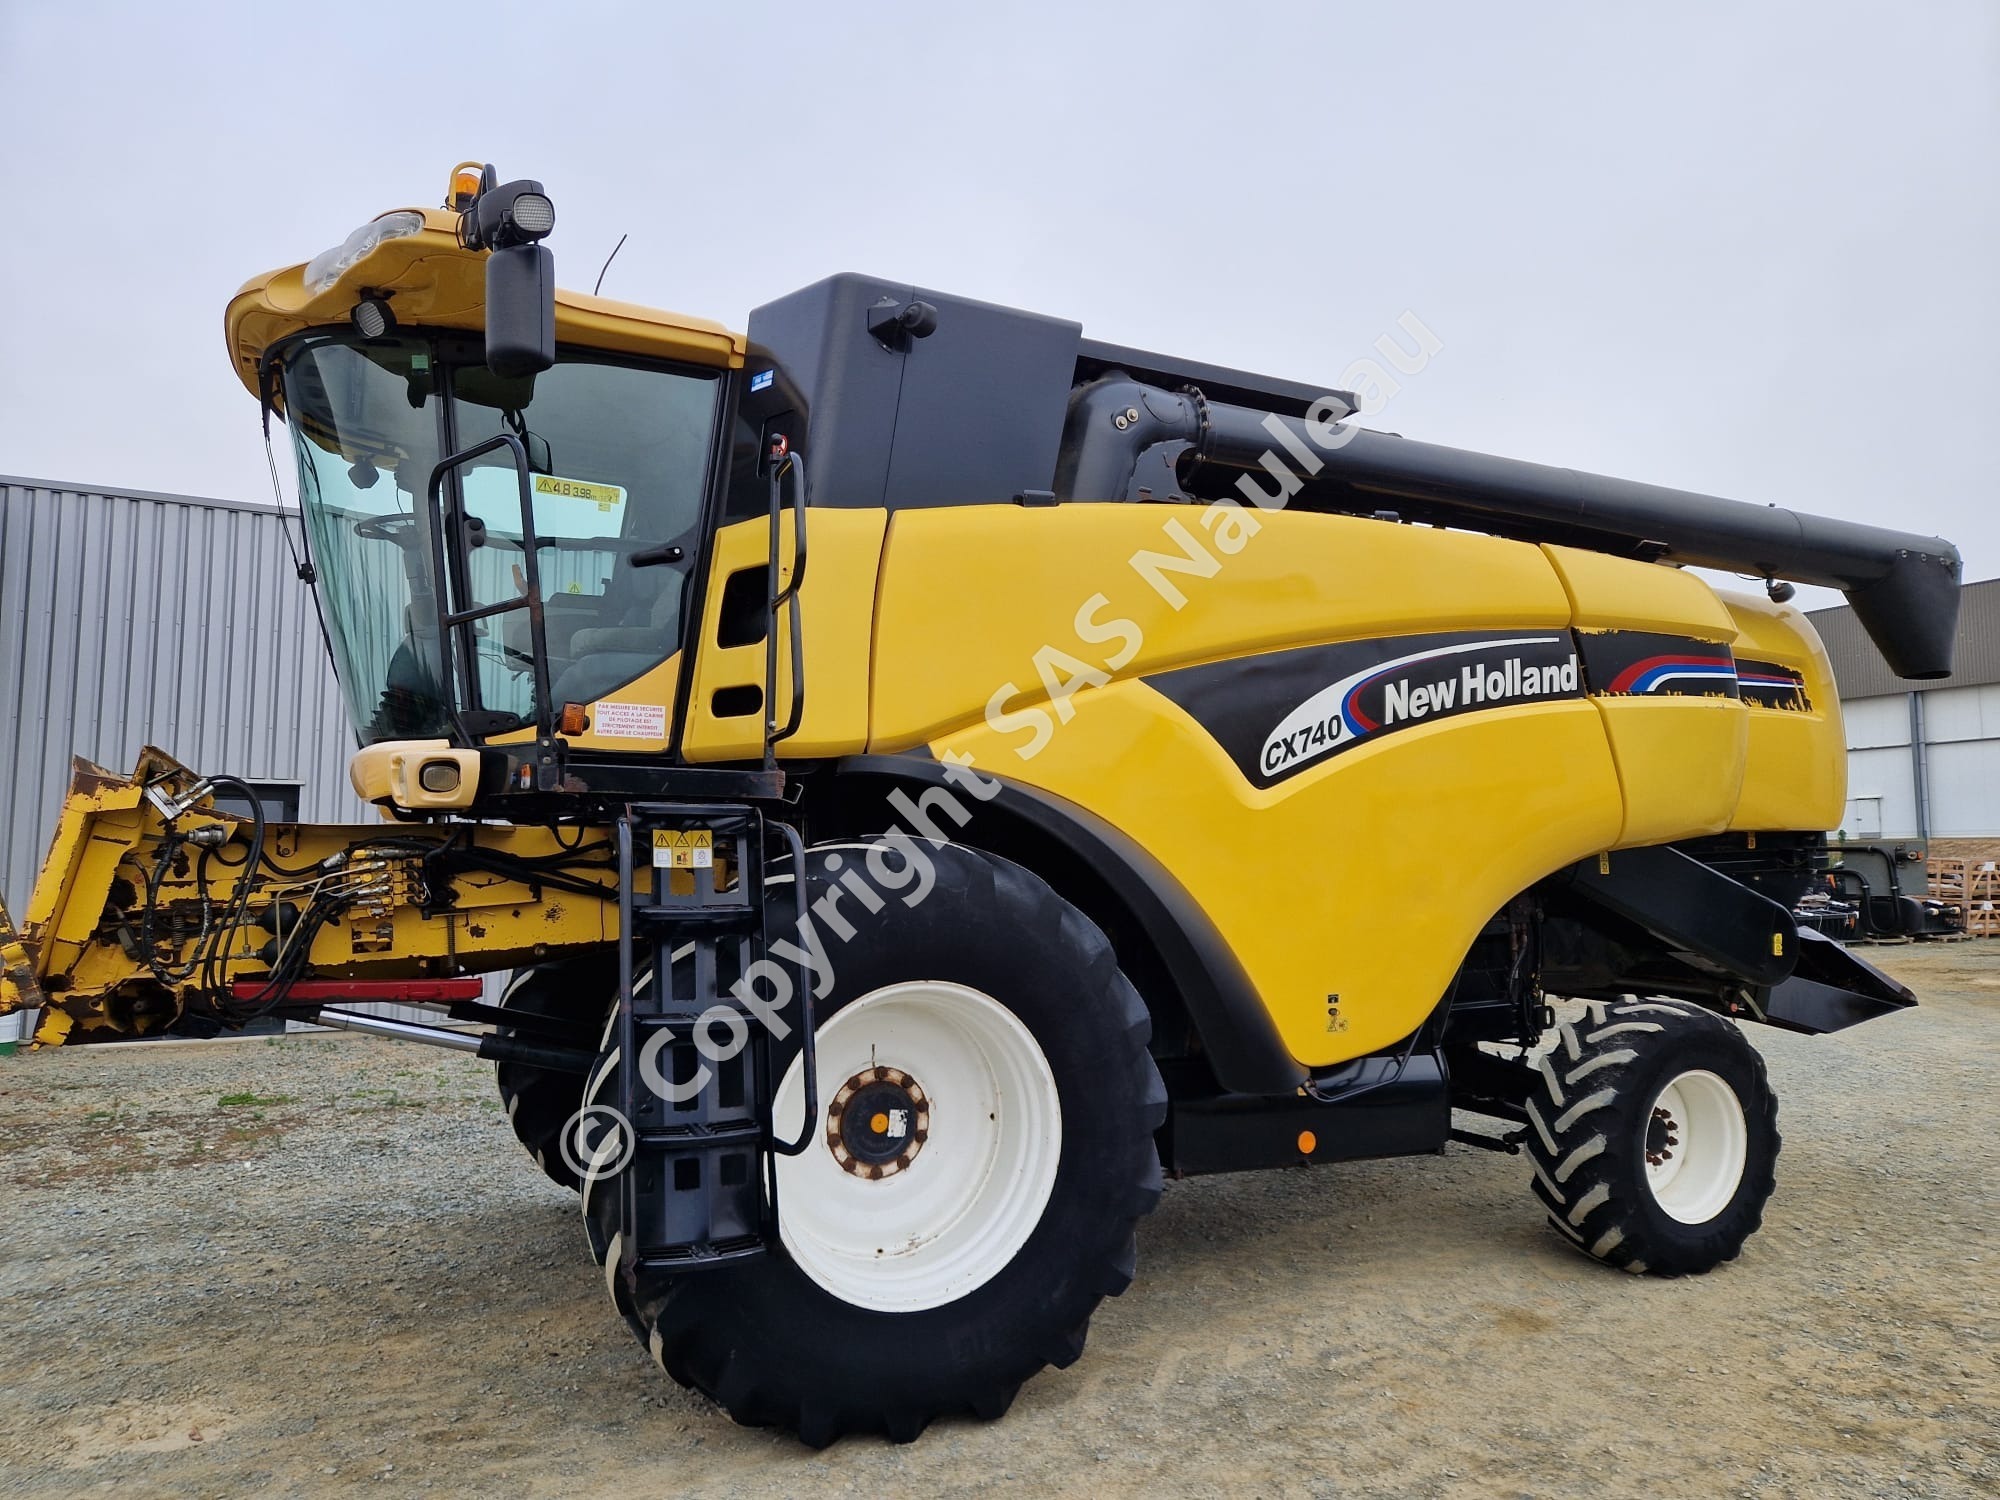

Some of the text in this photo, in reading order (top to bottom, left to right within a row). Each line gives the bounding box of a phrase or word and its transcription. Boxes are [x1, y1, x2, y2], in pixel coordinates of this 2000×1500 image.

[1384, 654, 1577, 725] New Holland
[1265, 715, 1342, 771] CX740
